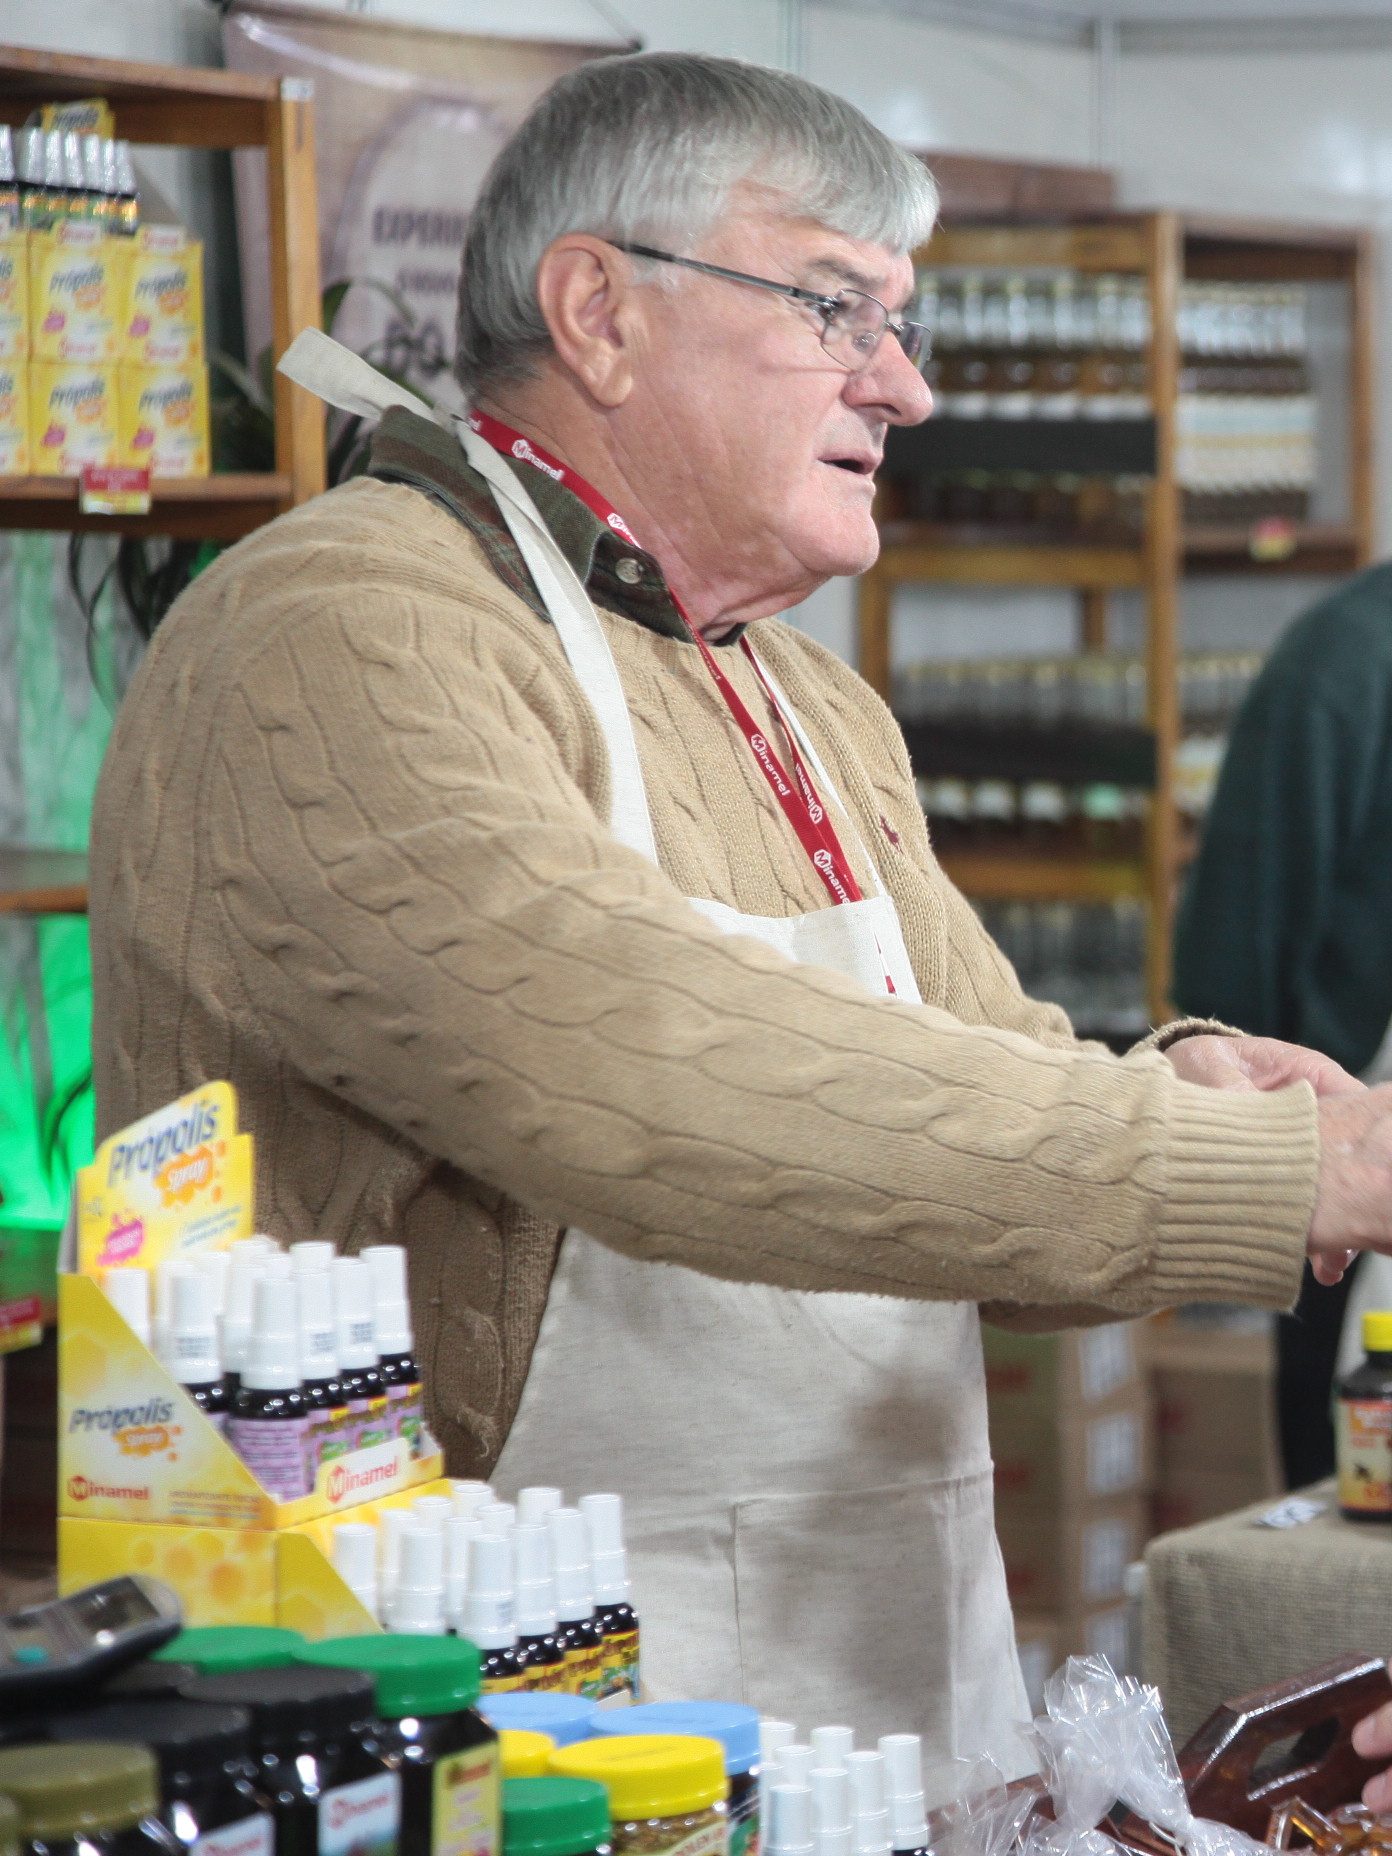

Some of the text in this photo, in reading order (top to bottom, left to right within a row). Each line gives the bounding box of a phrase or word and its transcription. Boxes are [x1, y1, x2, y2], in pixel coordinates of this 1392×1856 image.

[511, 438, 565, 482] Minamel
[751, 733, 791, 796] Minamel
[795, 762, 823, 825] Minamel
[813, 848, 850, 904] Miname
[66, 1474, 150, 1502] Minamel
[326, 1455, 399, 1504] Minamel
